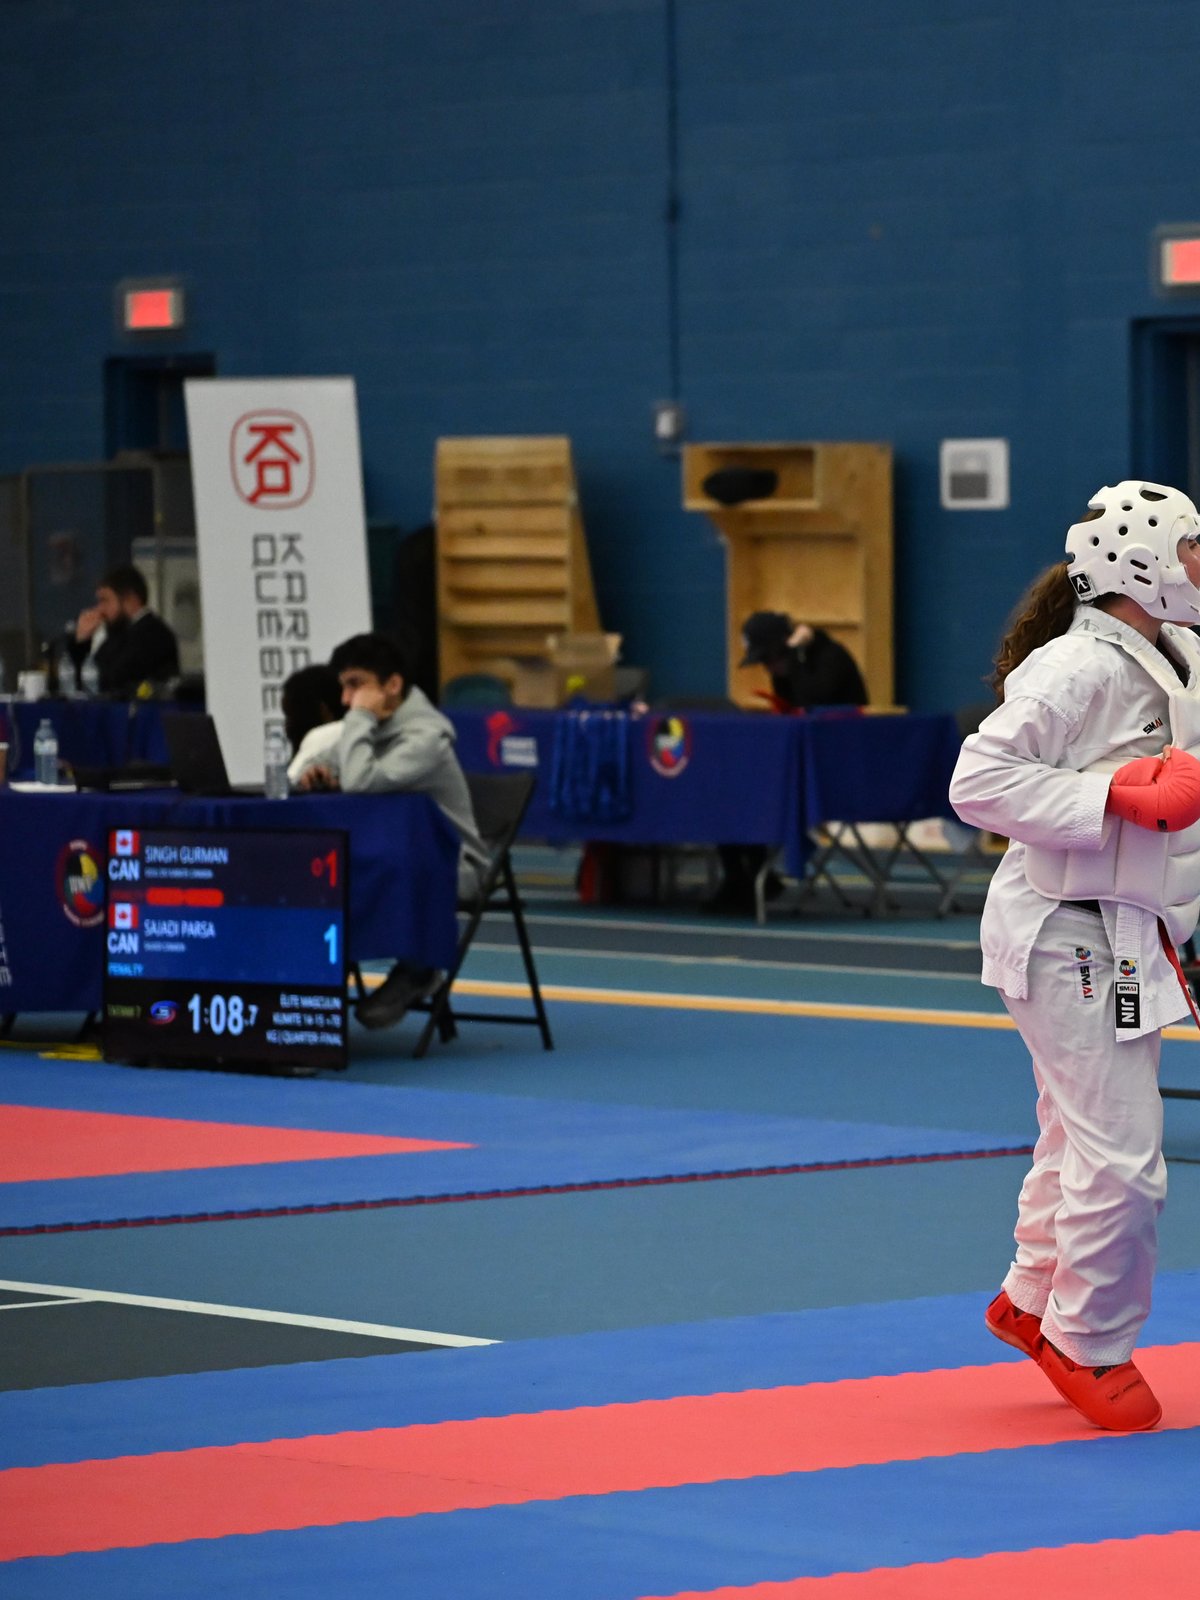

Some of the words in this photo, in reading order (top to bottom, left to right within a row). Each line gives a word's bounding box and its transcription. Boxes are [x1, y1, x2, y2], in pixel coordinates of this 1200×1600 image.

[281, 533, 312, 670] KARA
[1143, 717, 1164, 735] SMAI
[145, 845, 178, 863] SINGH
[180, 846, 229, 864] GURMAN
[108, 859, 140, 881] CAN
[325, 851, 338, 888] 1
[181, 920, 216, 939] PARSA
[107, 932, 139, 955] CAN
[323, 923, 338, 965] 1
[1080, 965, 1094, 999] SMAI
[1121, 997, 1135, 1023] JIN
